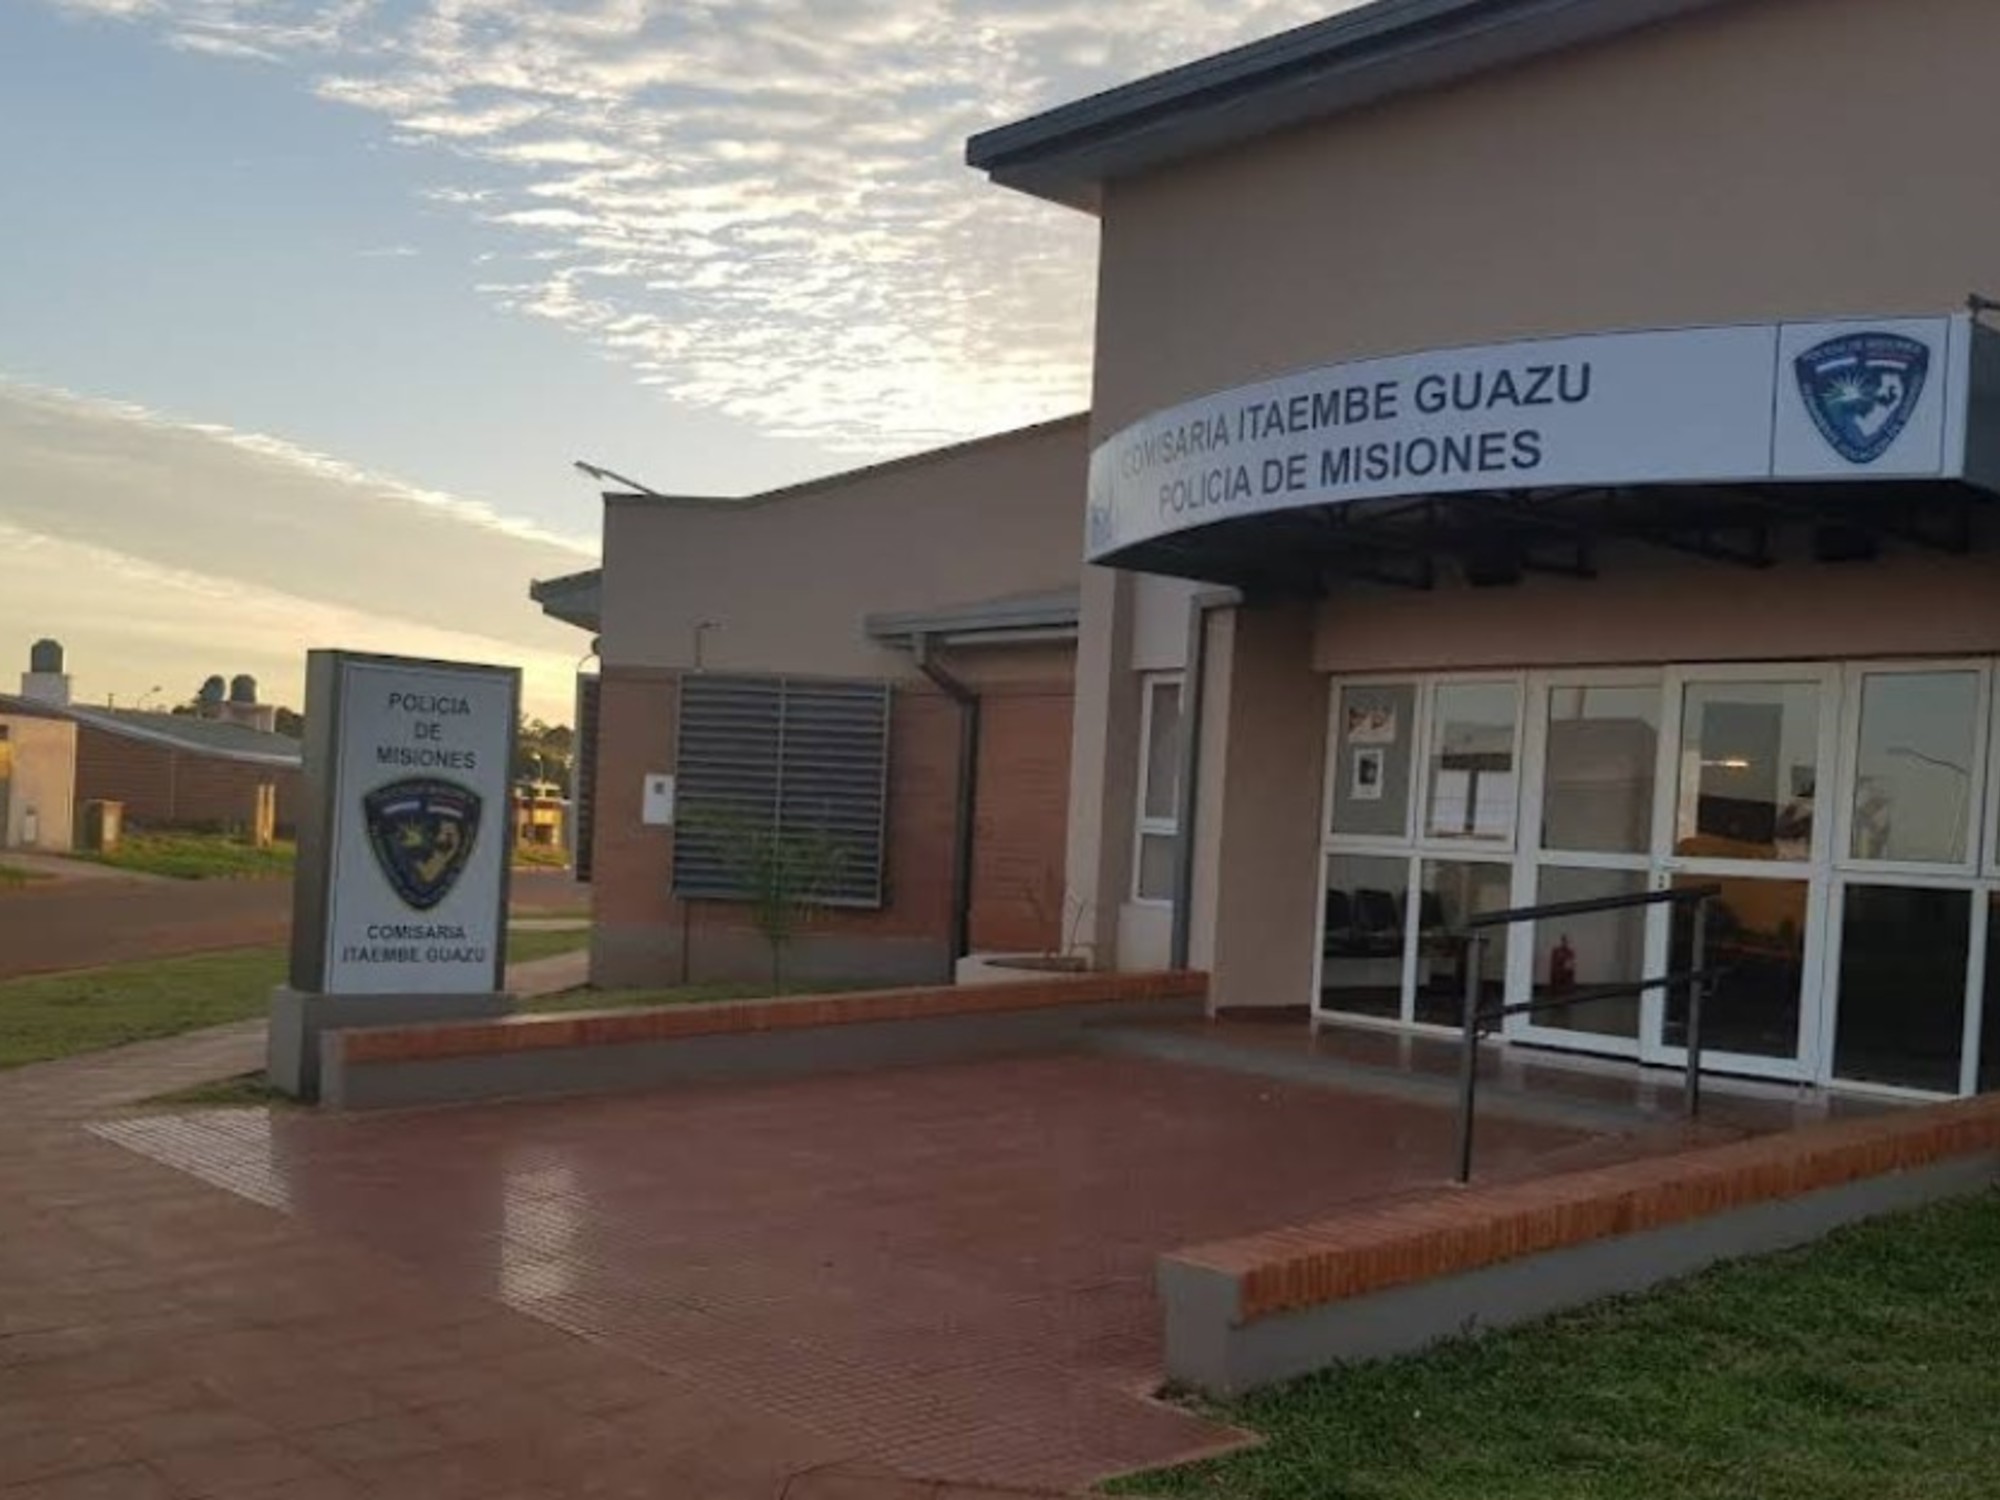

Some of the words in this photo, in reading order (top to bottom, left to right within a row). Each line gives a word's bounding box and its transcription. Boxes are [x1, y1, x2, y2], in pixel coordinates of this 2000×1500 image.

[1120, 415, 1230, 481] COMISARIA
[1236, 381, 1398, 443] ITAEMBE
[1414, 362, 1592, 415] GUAZU
[1158, 465, 1252, 516] POLICIA
[1261, 454, 1308, 494] DE
[1320, 429, 1543, 487] MISIONES
[388, 692, 471, 716] POLICIA
[414, 722, 442, 741] DE
[376, 746, 477, 769] MISIONES
[366, 924, 467, 941] COMISARIA
[342, 946, 421, 963] ITAEMBE
[427, 947, 485, 963] GUAZU
